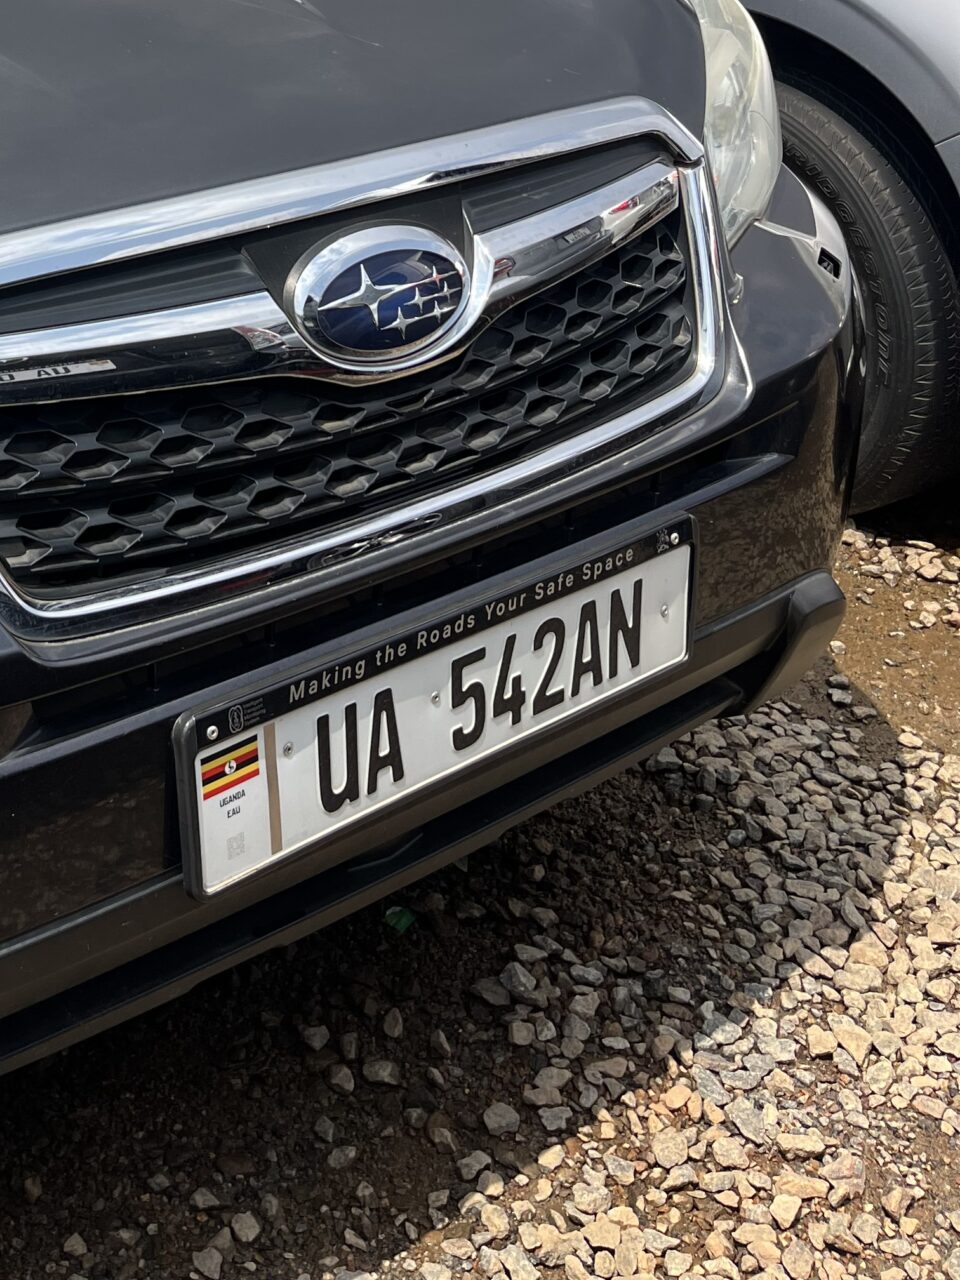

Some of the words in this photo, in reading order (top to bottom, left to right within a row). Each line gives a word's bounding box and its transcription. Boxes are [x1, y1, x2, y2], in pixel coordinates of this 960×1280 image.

[784, 144, 893, 386] RIDGESTONE
[289, 660, 366, 703] Making
[375, 644, 408, 666] the
[417, 614, 476, 650] Roads
[485, 592, 527, 620] Your
[534, 573, 574, 600] Safe
[582, 548, 634, 580] Space
[317, 687, 406, 813] UA
[450, 579, 644, 751] 542AN
[219, 789, 246, 808] UGANDA
[227, 806, 241, 819] EAU
